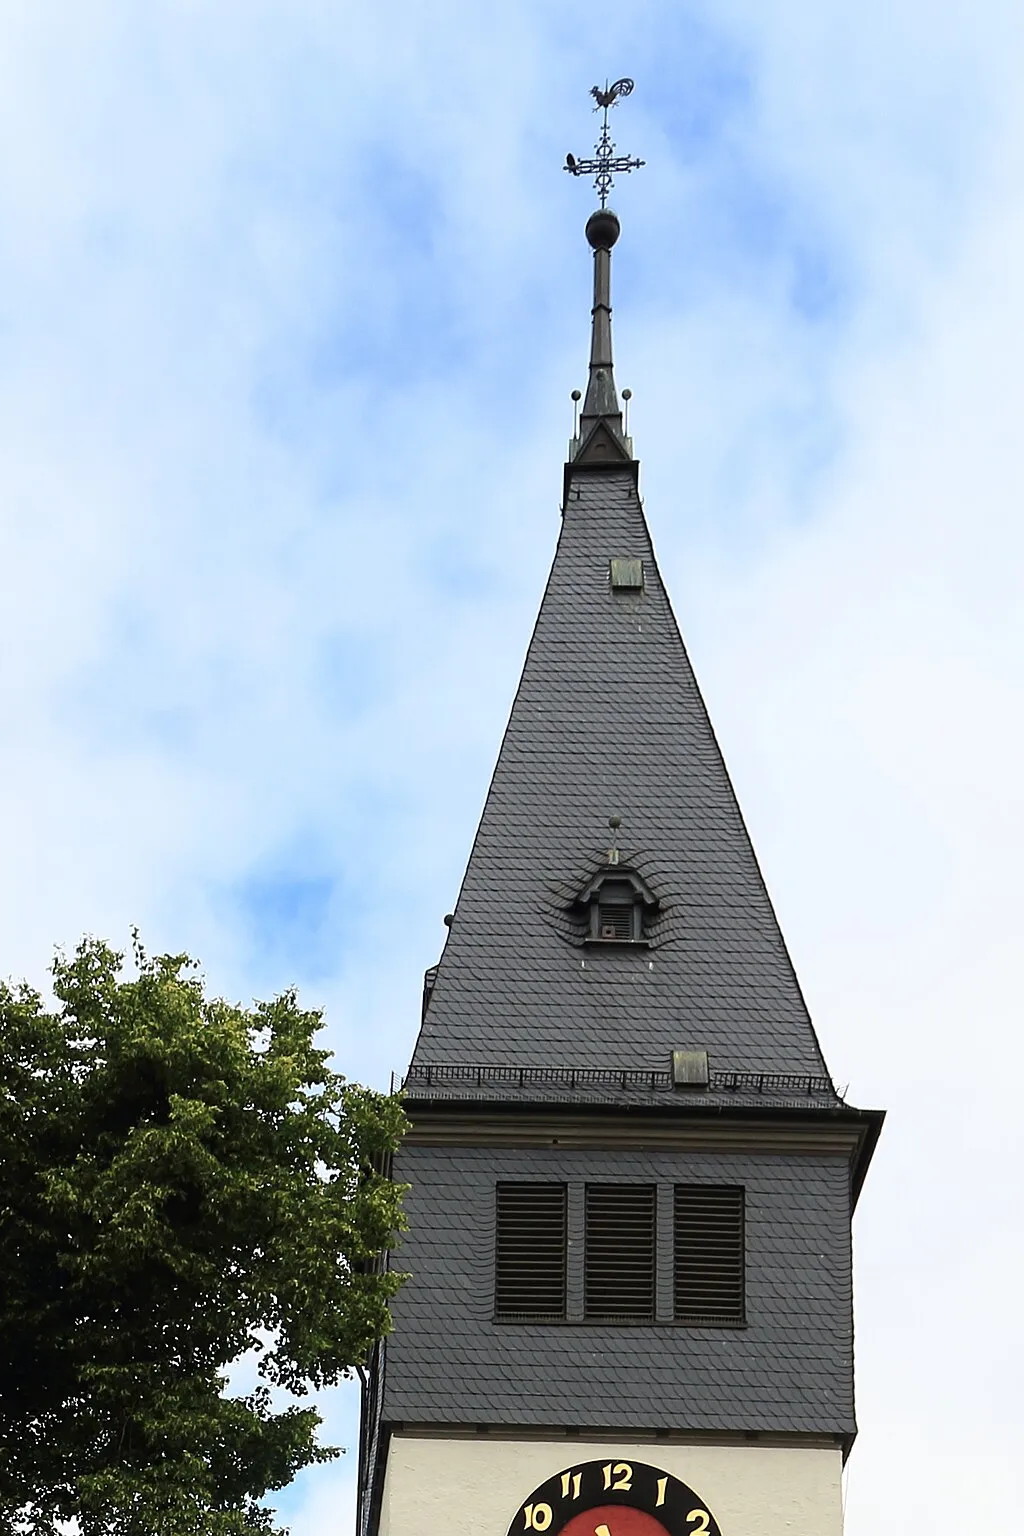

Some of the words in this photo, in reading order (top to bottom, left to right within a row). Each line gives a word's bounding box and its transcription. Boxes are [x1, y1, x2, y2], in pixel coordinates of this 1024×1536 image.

[561, 1472, 582, 1499] 11
[603, 1463, 632, 1491] 12
[655, 1477, 668, 1507] 1
[524, 1502, 553, 1531] 10
